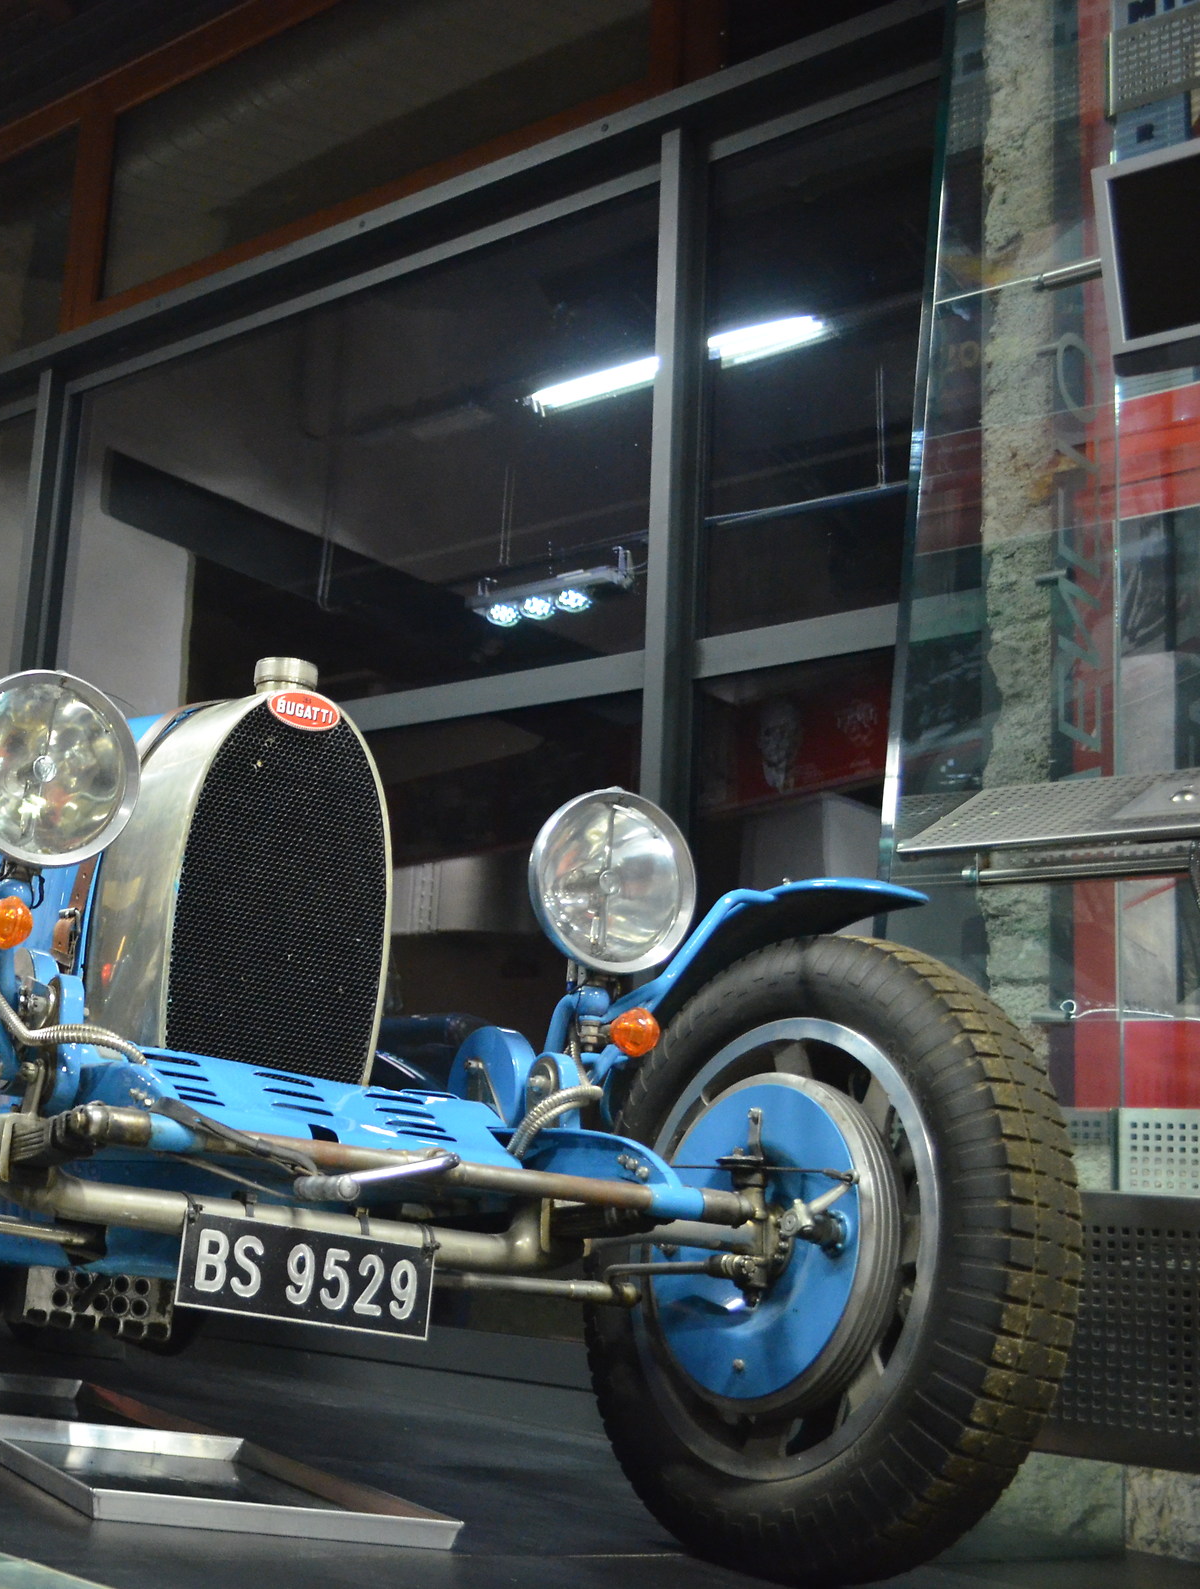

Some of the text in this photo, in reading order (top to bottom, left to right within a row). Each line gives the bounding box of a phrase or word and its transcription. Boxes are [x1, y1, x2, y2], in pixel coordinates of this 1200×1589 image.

[276, 695, 333, 724] BUGATTI
[194, 1228, 418, 1320] BS 9529
